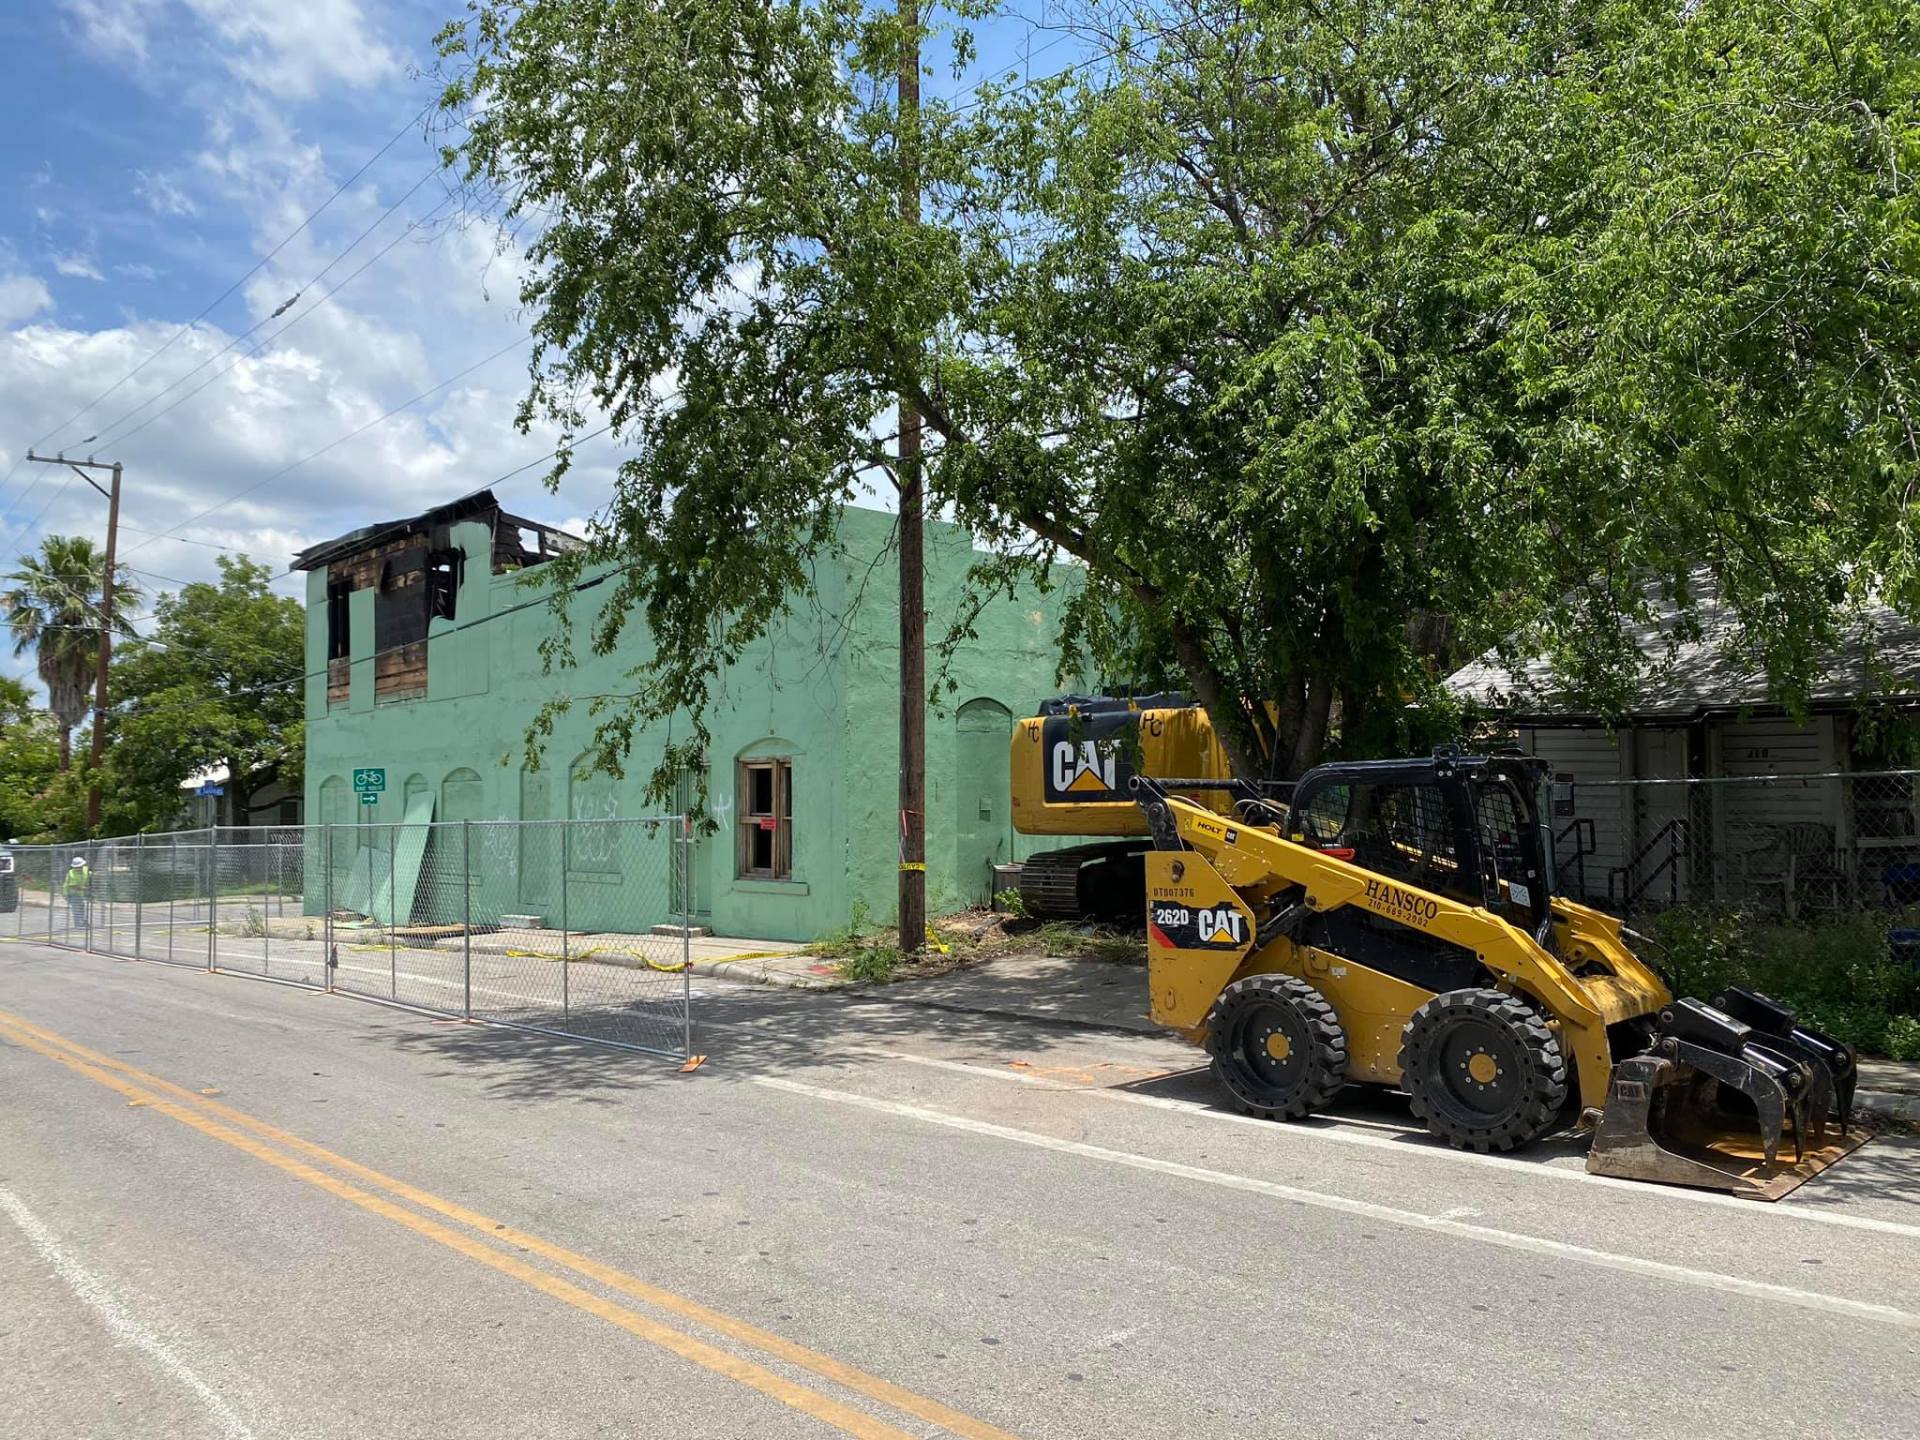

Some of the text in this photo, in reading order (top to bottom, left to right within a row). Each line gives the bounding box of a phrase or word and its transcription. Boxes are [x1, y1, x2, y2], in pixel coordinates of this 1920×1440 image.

[1053, 740, 1121, 792] CAT
[1197, 821, 1222, 834] HOLT
[1365, 879, 1438, 919] HANSCO
[1156, 908, 1189, 925] 262D
[1198, 909, 1243, 943] CAT
